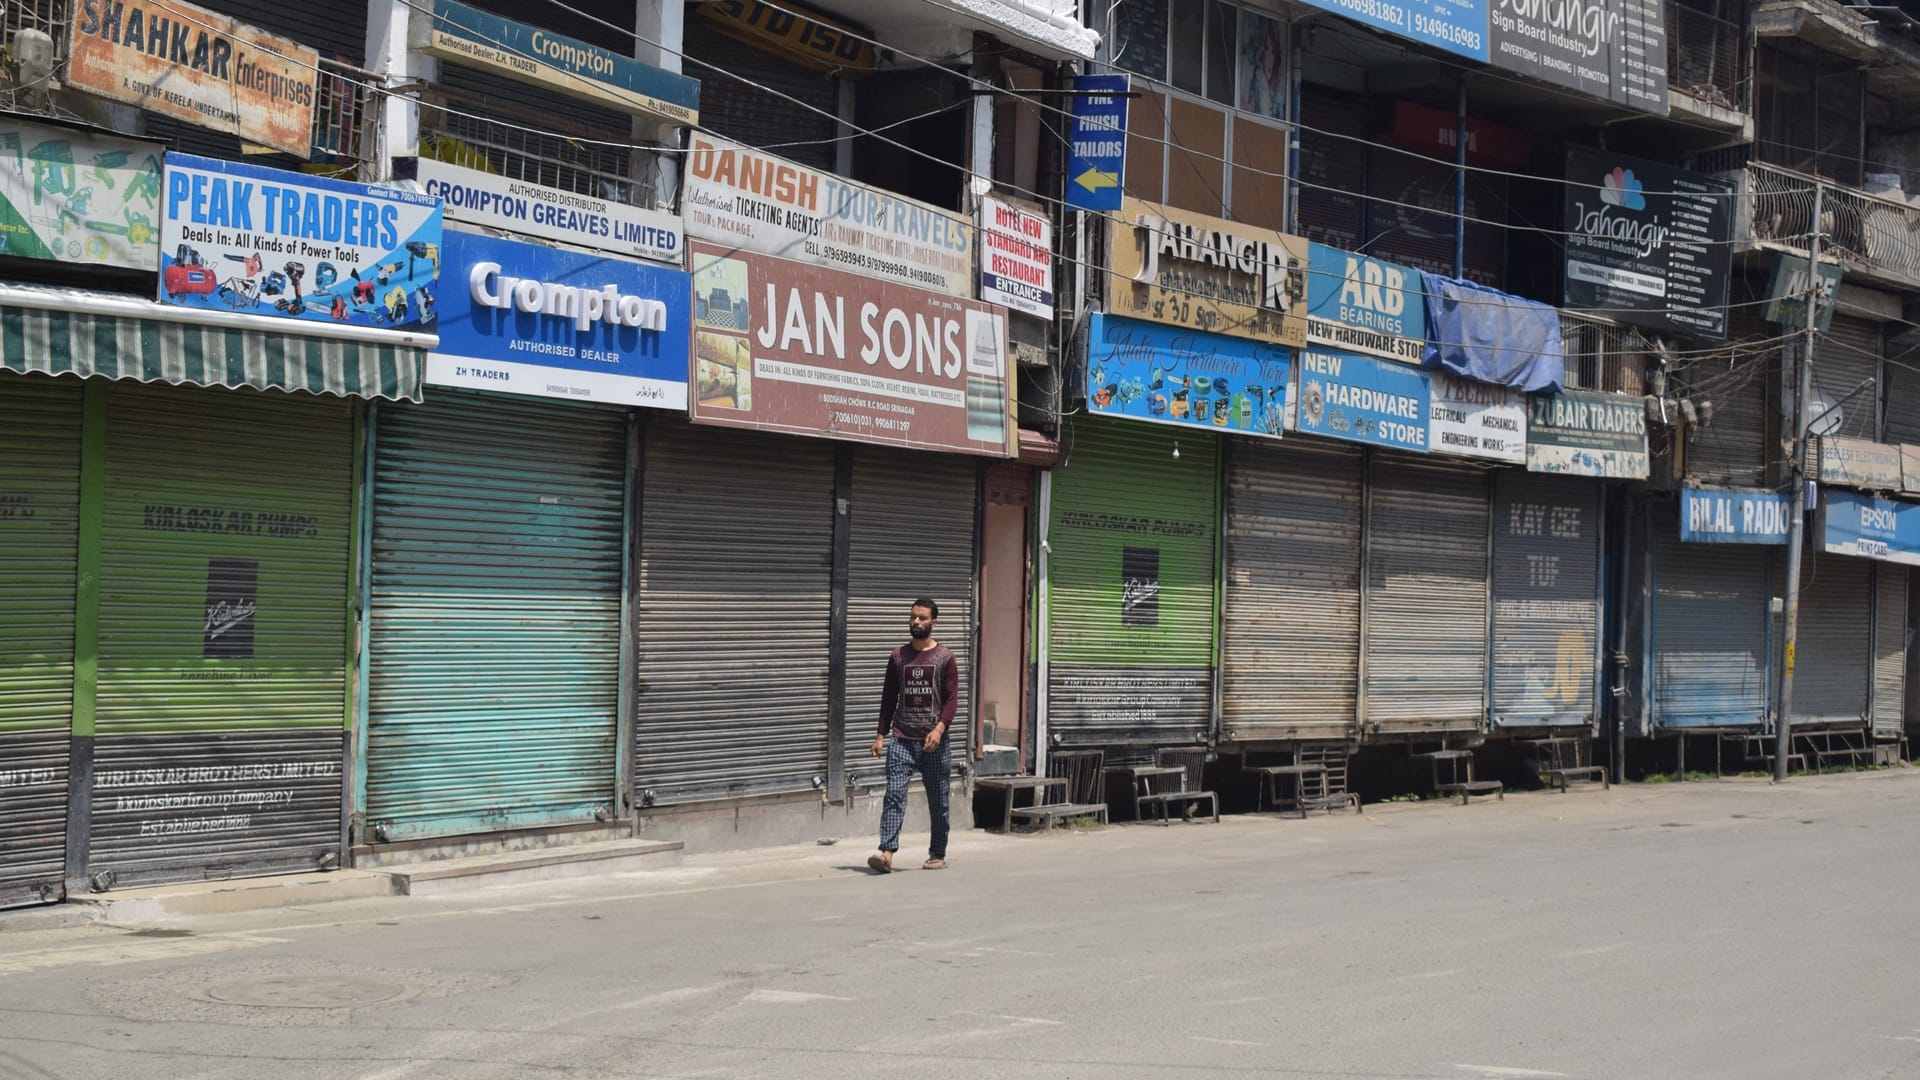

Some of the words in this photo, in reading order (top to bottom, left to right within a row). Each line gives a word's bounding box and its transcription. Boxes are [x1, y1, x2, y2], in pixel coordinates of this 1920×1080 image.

[81, 0, 232, 81] SHAHKAR
[1415, 14, 1481, 50] 9149616983
[1491, 10, 1514, 31] Sign
[1517, 24, 1546, 42] Board
[1548, 29, 1588, 58] Industry
[438, 33, 472, 54] Authorised
[473, 45, 494, 60] Dealer:
[509, 56, 537, 74] TRADERS
[531, 31, 614, 77] Crompton
[1500, 41, 1538, 62] ADVERTISING
[1543, 55, 1573, 74] BRANDING
[1577, 66, 1610, 85] PROMOTION
[235, 52, 312, 107] Enterprises
[164, 91, 193, 108] KERELA
[1079, 114, 1119, 132] FINISH
[1073, 141, 1122, 158] TAILORS
[692, 139, 819, 211] DANISH
[168, 170, 254, 230] PEAK
[261, 185, 398, 251] TRADERS
[426, 179, 528, 221] CROMPTON
[533, 205, 610, 237] GREAVES
[614, 220, 676, 251] LIMITED
[508, 183, 558, 204] AUTHORISED
[558, 193, 607, 214] DISTRIBUTOR
[735, 196, 782, 226] TICKETING
[824, 179, 877, 226] TOUR
[880, 198, 968, 252] TRAVELS
[838, 225, 865, 248] RAILWAY
[866, 231, 894, 256] TICKETING
[995, 206, 1022, 233] HOTEL
[1023, 216, 1042, 240] NEW
[1574, 202, 1669, 258] Jahangir
[182, 225, 213, 244] Deals
[217, 230, 231, 246] In:
[235, 232, 250, 249] All
[254, 235, 283, 253] Kinds
[286, 239, 298, 255] of
[300, 243, 332, 260] Power
[335, 246, 360, 263] Tools
[987, 227, 1032, 259] STANDARD
[1568, 233, 1586, 246] Sign
[1587, 236, 1610, 250] Board
[1611, 239, 1642, 259] Industry
[992, 253, 1046, 288] RESTAURANT
[1135, 213, 1290, 310] JAHANGIR
[470, 262, 667, 332] Crompton
[995, 277, 1042, 303] ENTRANCE
[1339, 256, 1404, 316] ARB
[757, 283, 846, 360] JAN
[860, 301, 962, 380] SONS
[1308, 319, 1333, 341] NEW
[1335, 329, 1396, 354] HARDWARE
[1340, 306, 1402, 334] BEARINGS
[509, 339, 576, 357] AUTHORISED
[581, 349, 620, 363] DEALER
[1305, 352, 1342, 377] NEW
[456, 366, 467, 376] ZH
[471, 368, 510, 381] TRADERS
[759, 363, 774, 374] DEALS
[783, 366, 792, 376] ALL
[792, 367, 806, 378] KINDS
[807, 369, 813, 379] OF
[814, 370, 841, 383] FURNISHING
[860, 377, 871, 387] SOFA
[848, 396, 867, 408] CHOWK
[876, 400, 891, 412] ROAD
[1326, 382, 1419, 419] HARDWARE
[1535, 399, 1588, 430] ZUBAIR
[1589, 404, 1645, 436] TRADERS
[1379, 421, 1425, 446] STORE
[1431, 407, 1467, 425] LECTRICALS
[1481, 415, 1519, 433] MECHANICAL
[1441, 431, 1478, 449] ENGINEERING
[1482, 436, 1504, 452] WORKS
[1689, 496, 1735, 534] BILAL
[1743, 495, 1790, 536] RADIO
[1861, 506, 1897, 532] EPSON
